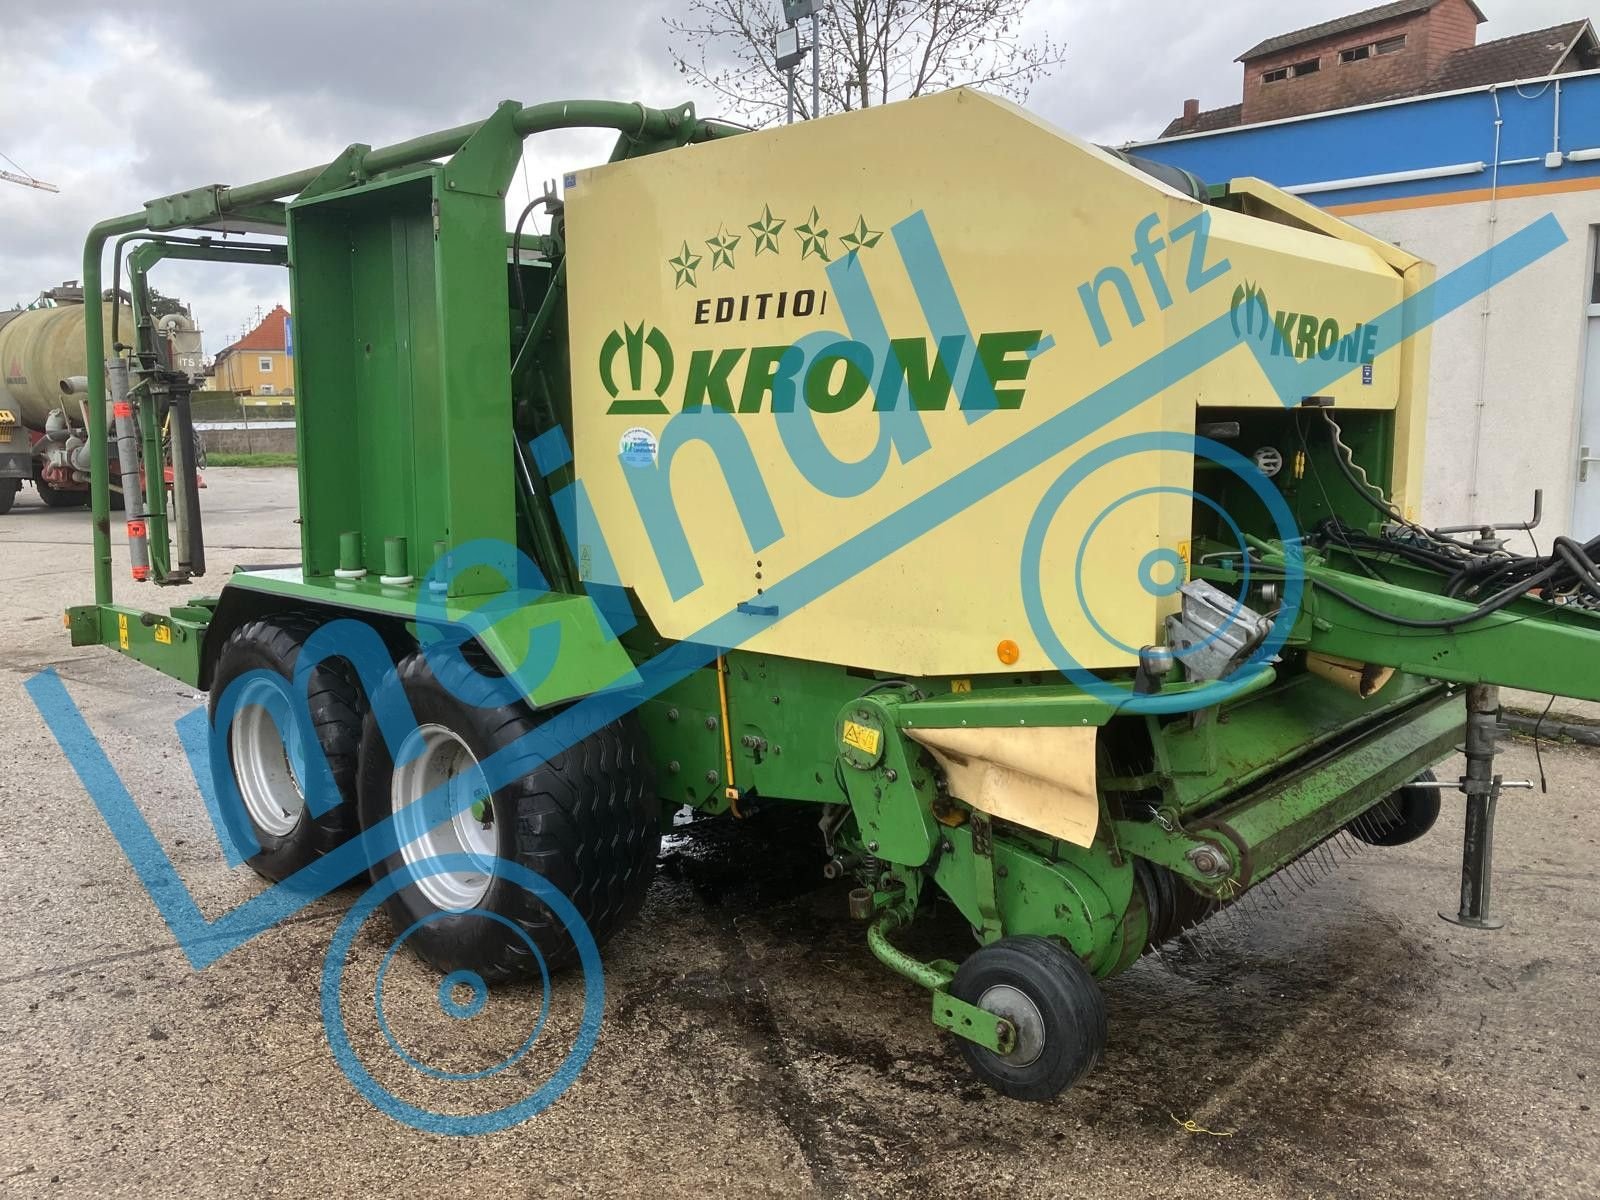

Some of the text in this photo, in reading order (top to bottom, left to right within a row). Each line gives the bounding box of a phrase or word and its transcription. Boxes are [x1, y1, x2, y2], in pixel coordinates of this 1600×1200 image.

[694, 289, 827, 325] EDITIO
[1270, 310, 1379, 365] KRONE
[681, 329, 1043, 415] KRONE
